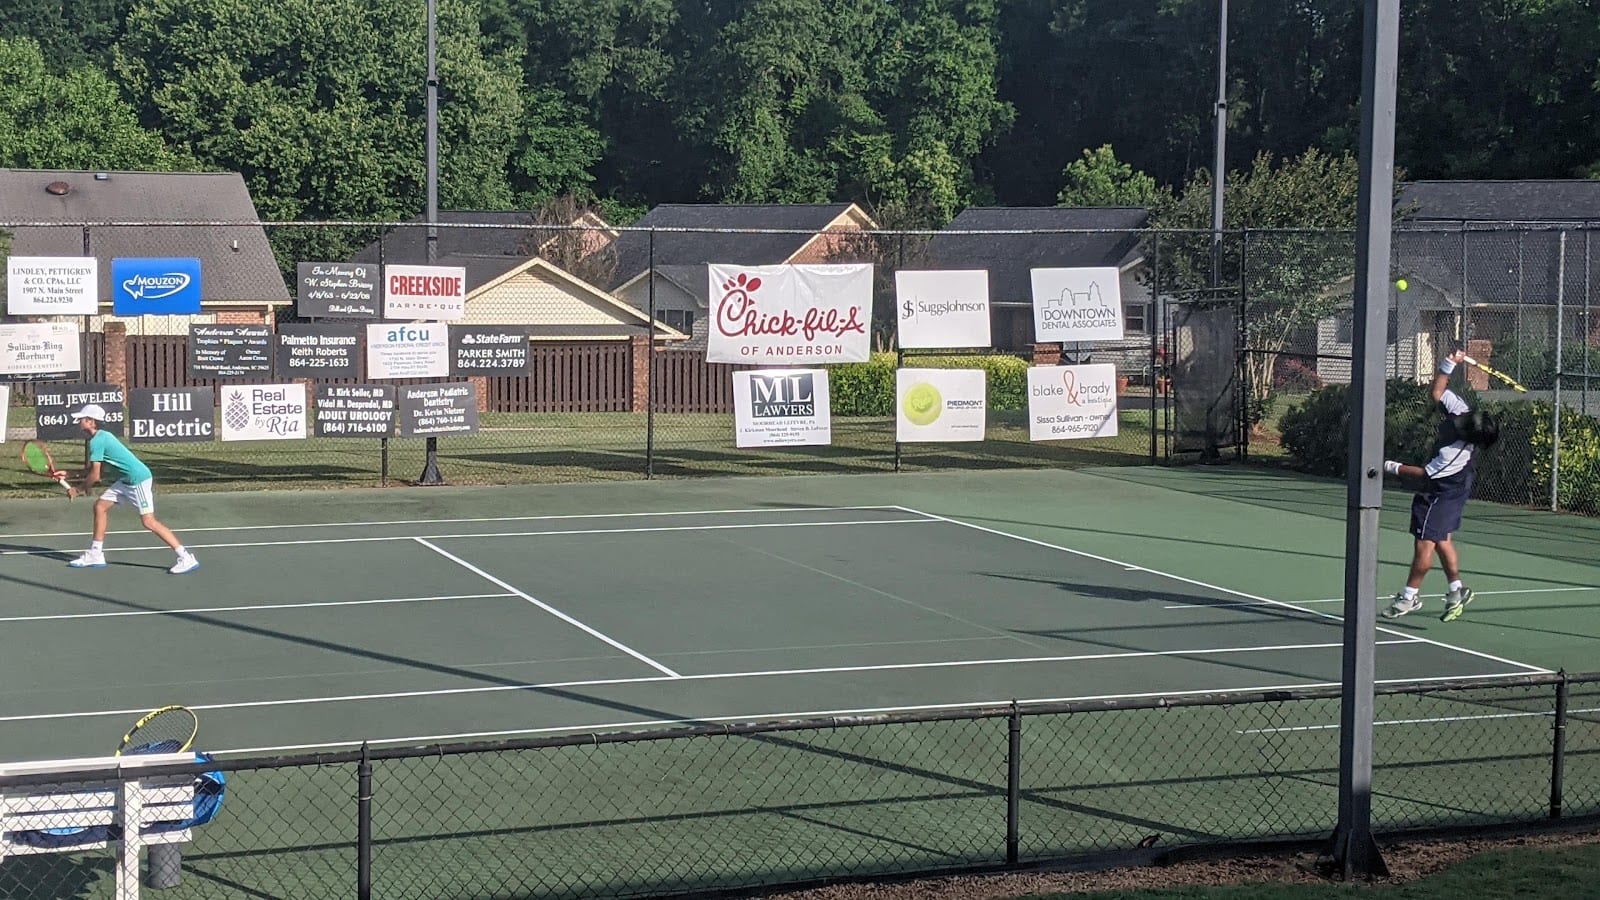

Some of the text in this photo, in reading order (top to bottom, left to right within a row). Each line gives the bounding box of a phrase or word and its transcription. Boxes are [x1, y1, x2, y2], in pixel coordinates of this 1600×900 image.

[12, 268, 47, 276] LINDLEY,
[138, 277, 183, 285] MOUZON
[390, 275, 461, 297] CREEKSIDE
[918, 299, 985, 316] SuggsJohnson
[717, 289, 865, 342] Chick-fil-A
[1044, 308, 1115, 320] DOWNTOWN
[1042, 320, 1116, 329] DENTAL ASSOCIATES
[387, 326, 429, 342] afcu
[281, 335, 356, 345] Palmetto Insurance
[292, 347, 347, 356] Keith Roberts
[458, 349, 525, 358] PARKER SMITH
[741, 345, 842, 356] OF ANDERSON
[289, 358, 349, 367] 864-225-1633
[458, 359, 525, 368] 864.224.3789
[328, 388, 335, 396] R.
[336, 388, 350, 396] Kirk
[372, 388, 384, 397] MD
[407, 387, 469, 399] Anderson Pediatric
[1032, 370, 1110, 407] blake & brady
[37, 392, 123, 408] PHIL JEWELERS
[252, 388, 285, 401] Real
[152, 393, 192, 412] Hill
[318, 400, 335, 408] Vidal
[337, 400, 345, 408] M.
[382, 400, 393, 408] MD
[424, 398, 454, 407] Dentistry
[253, 403, 302, 415] Estate
[425, 408, 442, 416] Kevin
[754, 404, 813, 416] LAWYERS
[39, 414, 68, 426] (864)
[318, 411, 392, 420] ADULT UROLOGY
[1036, 416, 1055, 424] Sissa
[133, 418, 212, 437] Electric
[254, 416, 299, 436] by Ria
[323, 422, 387, 434] (864) 716-6100
[1052, 424, 1098, 433] 864-965-9120
